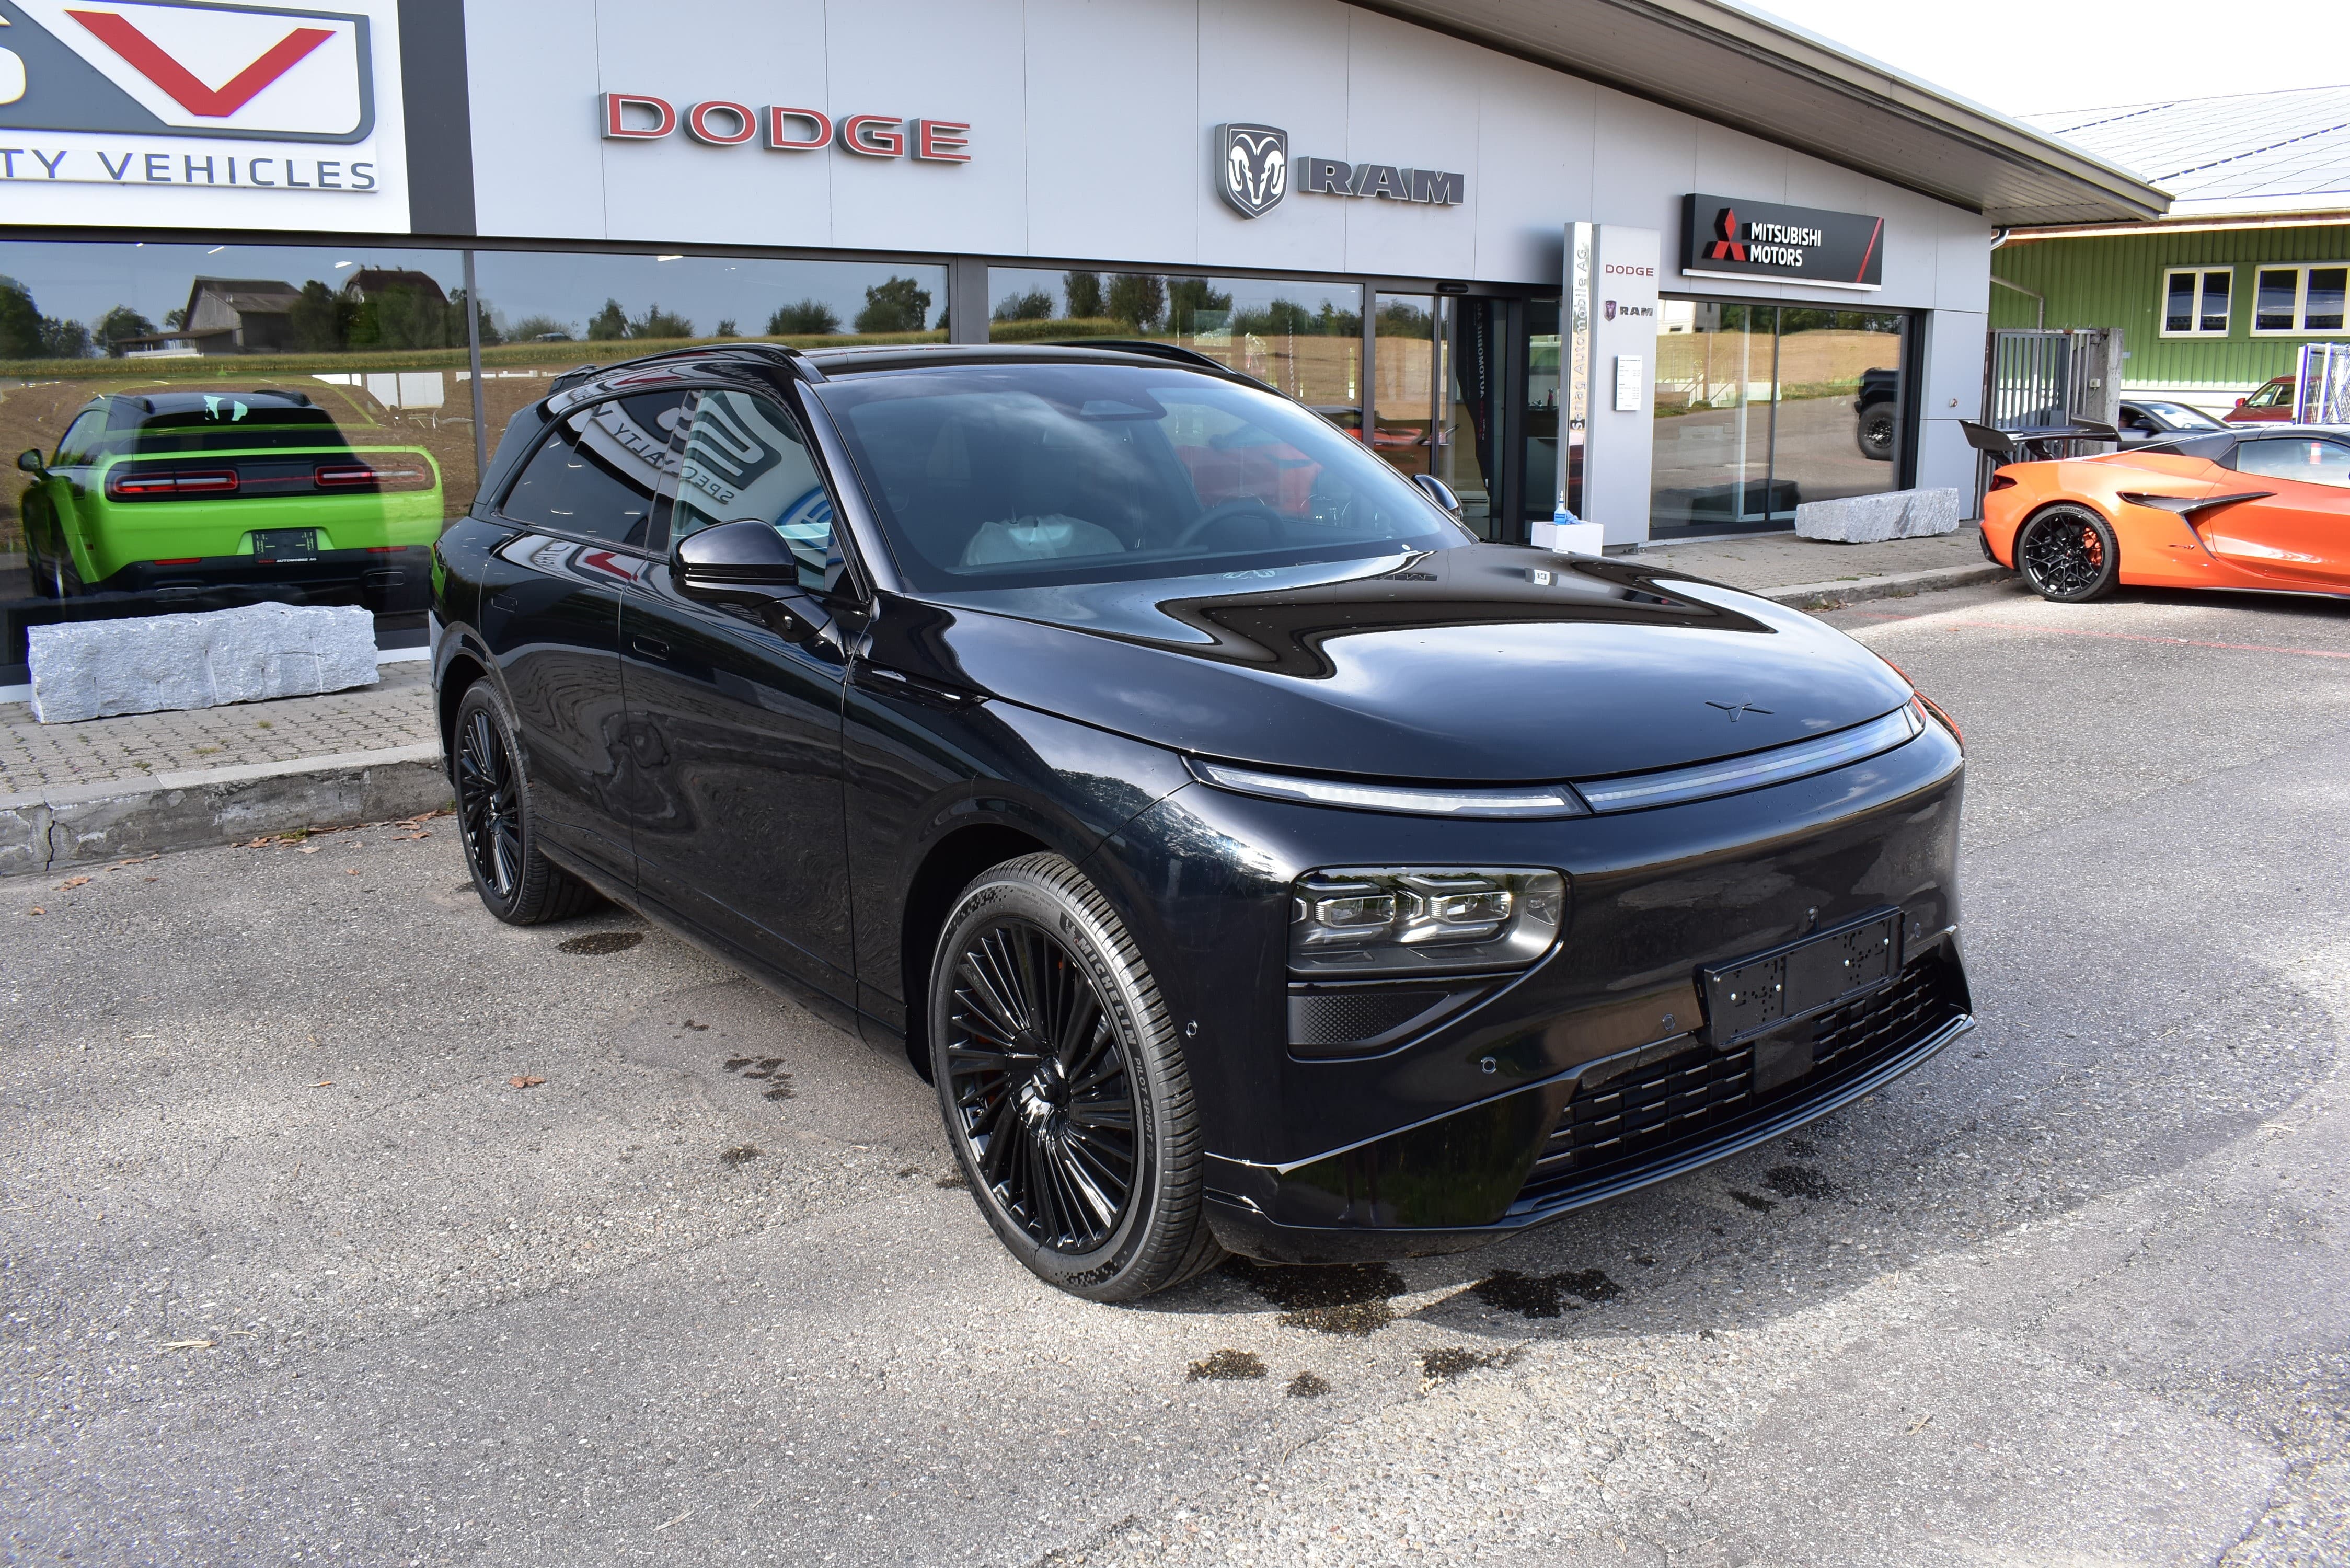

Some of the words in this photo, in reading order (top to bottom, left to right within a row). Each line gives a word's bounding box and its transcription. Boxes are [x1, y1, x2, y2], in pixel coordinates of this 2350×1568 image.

[601, 91, 972, 165] DODGE
[97, 151, 376, 190] VEHICLES
[1298, 156, 1465, 206] RAM
[1751, 222, 1822, 247] MITSUBISHI
[1577, 249, 1587, 272] AG
[1605, 264, 1654, 276] DODGE
[1750, 244, 1803, 267] MOTORS
[1574, 278, 1587, 375] Automobile
[1619, 306, 1653, 317] RAM
[1078, 937, 1137, 1045] MICHELIN
[1134, 1057, 1147, 1095] PILOT
[1143, 1098, 1153, 1142] SPORT
